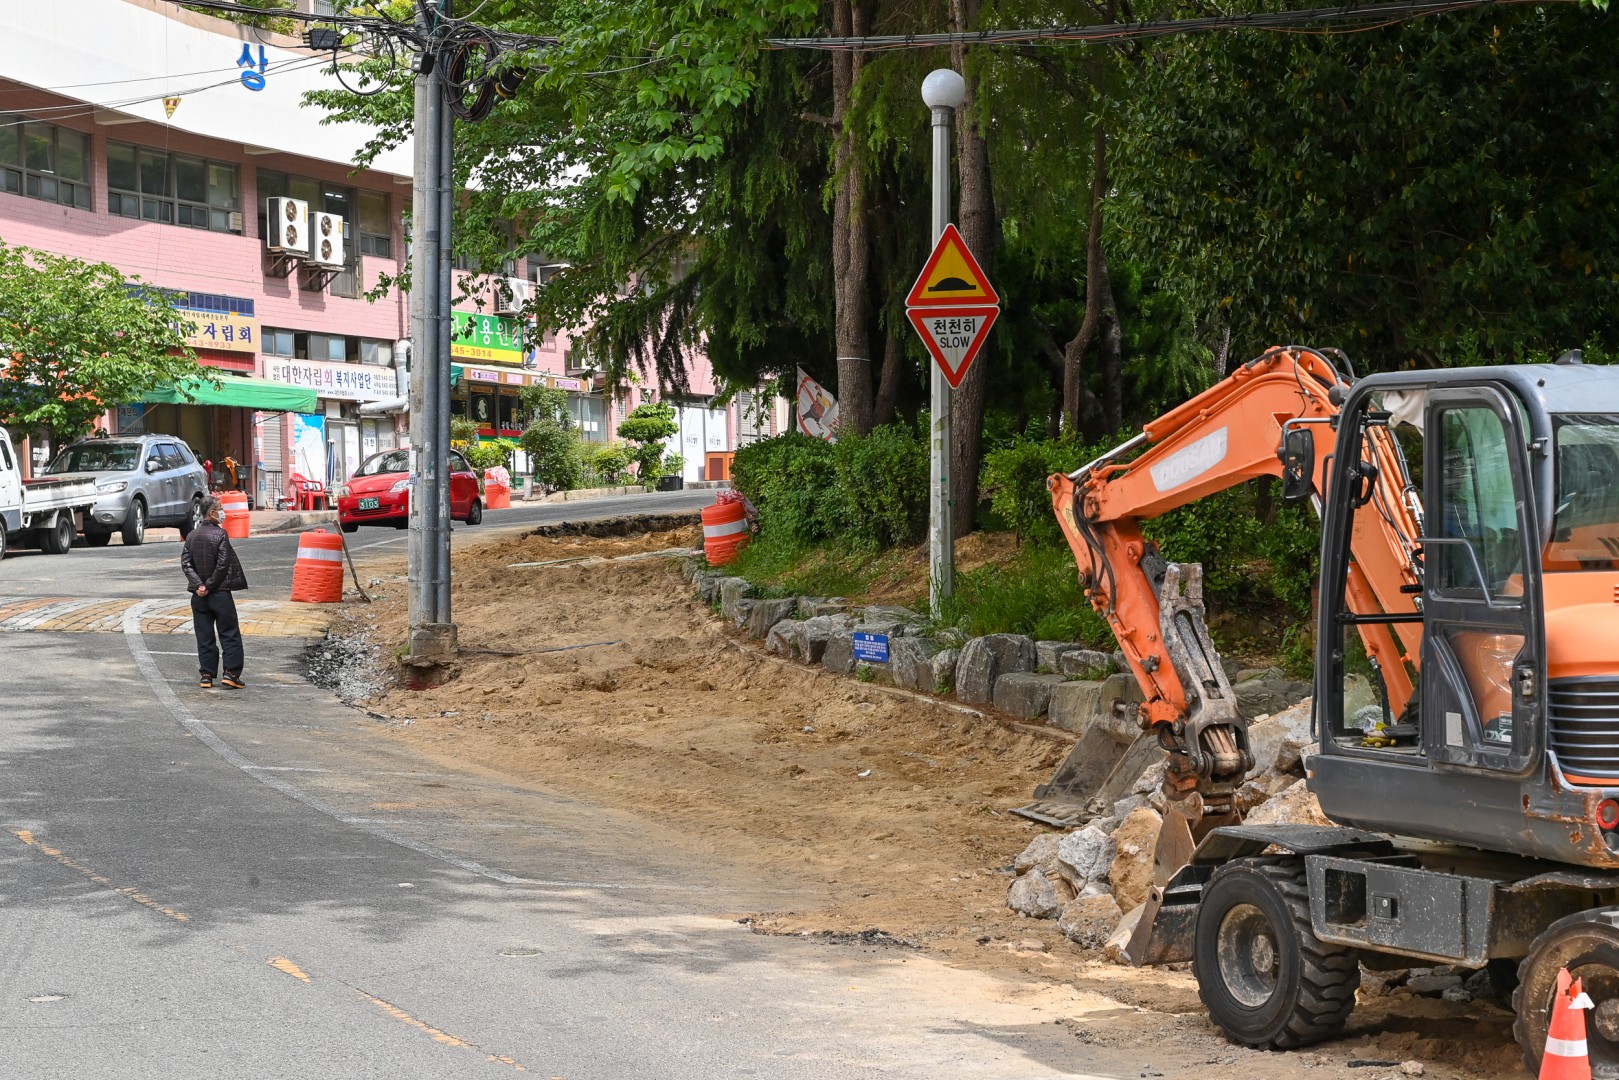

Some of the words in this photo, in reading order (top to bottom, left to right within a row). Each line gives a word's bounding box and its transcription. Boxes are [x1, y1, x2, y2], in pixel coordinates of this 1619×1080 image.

[237, 43, 268, 91] 상
[933, 318, 976, 335] 천천히
[939, 336, 970, 348] SLOW
[282, 364, 332, 387] 대한자립회
[336, 370, 371, 389] 복지사업단
